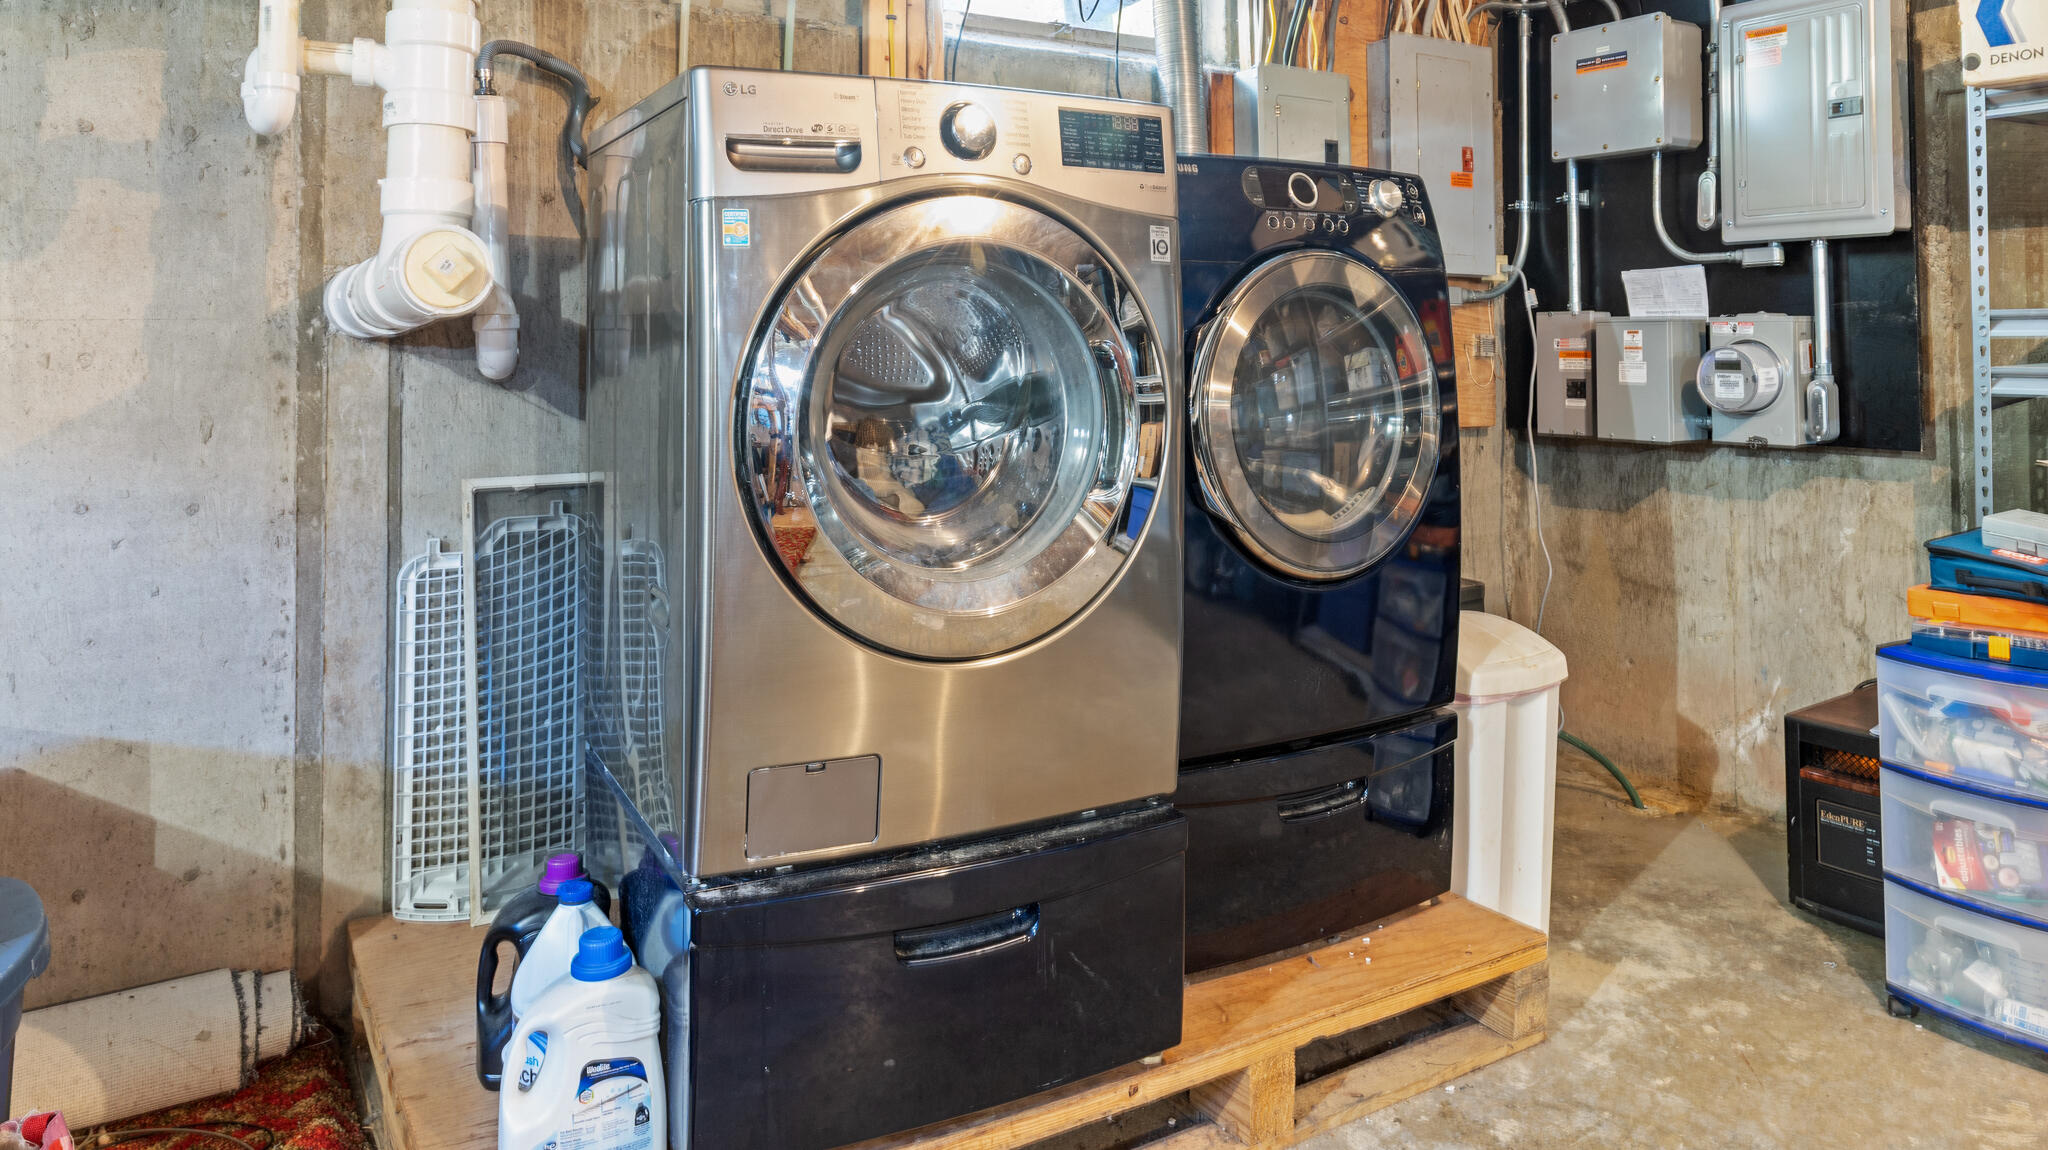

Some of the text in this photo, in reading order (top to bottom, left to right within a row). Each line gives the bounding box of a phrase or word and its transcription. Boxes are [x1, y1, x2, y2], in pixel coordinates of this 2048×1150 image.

[1990, 47, 2044, 65] DENON
[740, 85, 757, 95] LG
[763, 125, 785, 133] Direct
[785, 126, 804, 134] Drive
[1152, 239, 1169, 256] 10
[1820, 810, 1865, 828] EdenPURE
[1955, 828, 1969, 882] adjustables
[586, 1063, 610, 1074] Woolite
